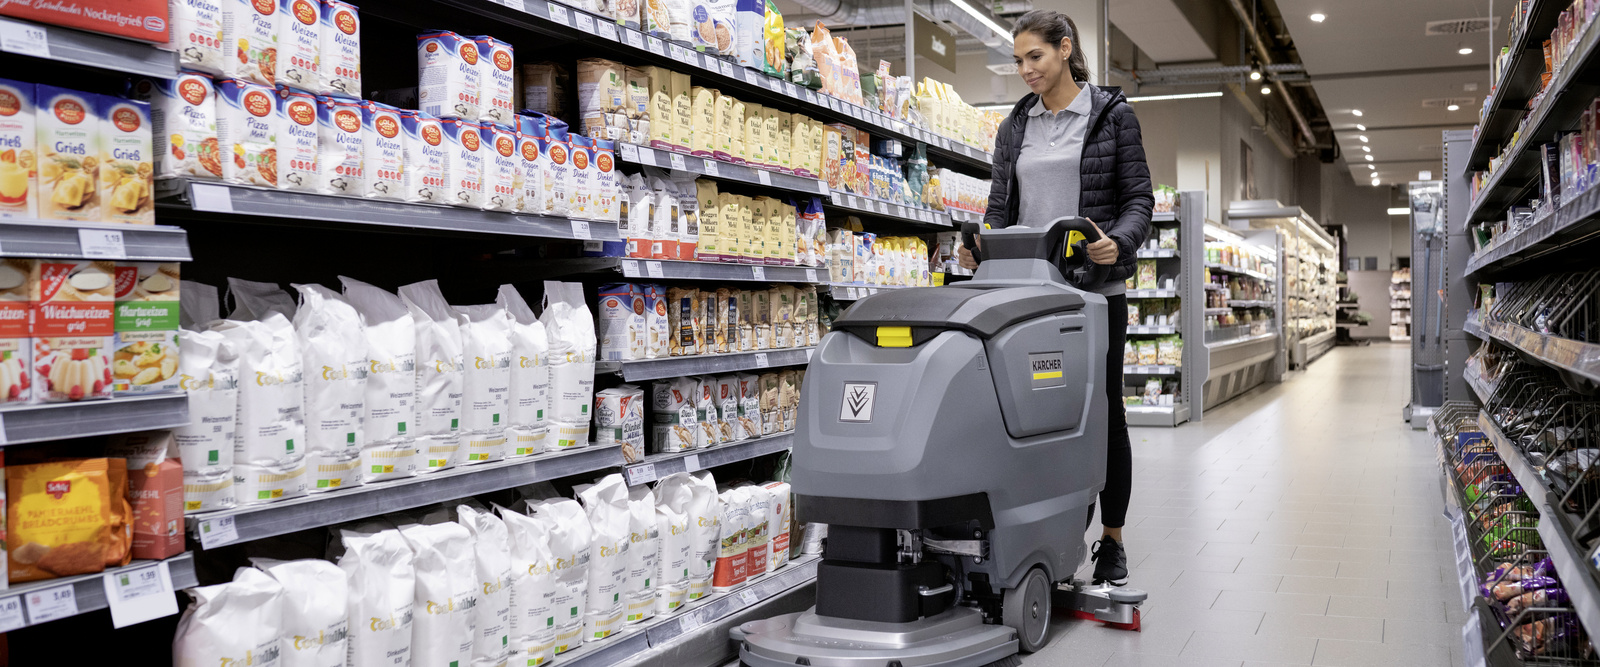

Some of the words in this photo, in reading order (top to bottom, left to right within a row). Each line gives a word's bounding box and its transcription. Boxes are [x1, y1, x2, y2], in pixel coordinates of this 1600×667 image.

[187, 0, 219, 13] Weizen
[83, 7, 143, 27] Nockerlgrieß
[252, 14, 272, 30] Pizza
[291, 21, 318, 40] Weizen
[297, 36, 312, 46] Mehl
[334, 33, 358, 48] Weizen
[342, 46, 354, 55] Mehl
[459, 63, 479, 76] Weizen
[492, 68, 512, 83] Weizen
[183, 106, 206, 119] Pizza
[246, 116, 269, 131] Pizza
[249, 129, 267, 139] Mehl
[288, 124, 316, 138] Weizen
[55, 141, 86, 155] Grieß
[296, 138, 311, 146] Mehl
[376, 137, 401, 150] Weizen
[113, 148, 140, 161] Grieß
[383, 149, 395, 157] Mehl
[460, 150, 480, 162] Weizen
[495, 156, 514, 168] Weizen
[573, 168, 589, 179] Dinkel
[597, 171, 614, 181] Dinkel
[701, 210, 717, 218] Roggen
[41, 305, 113, 319] Weichweizen-
[1032, 359, 1062, 371] KÄRCHER
[624, 420, 642, 435] Dinkel
